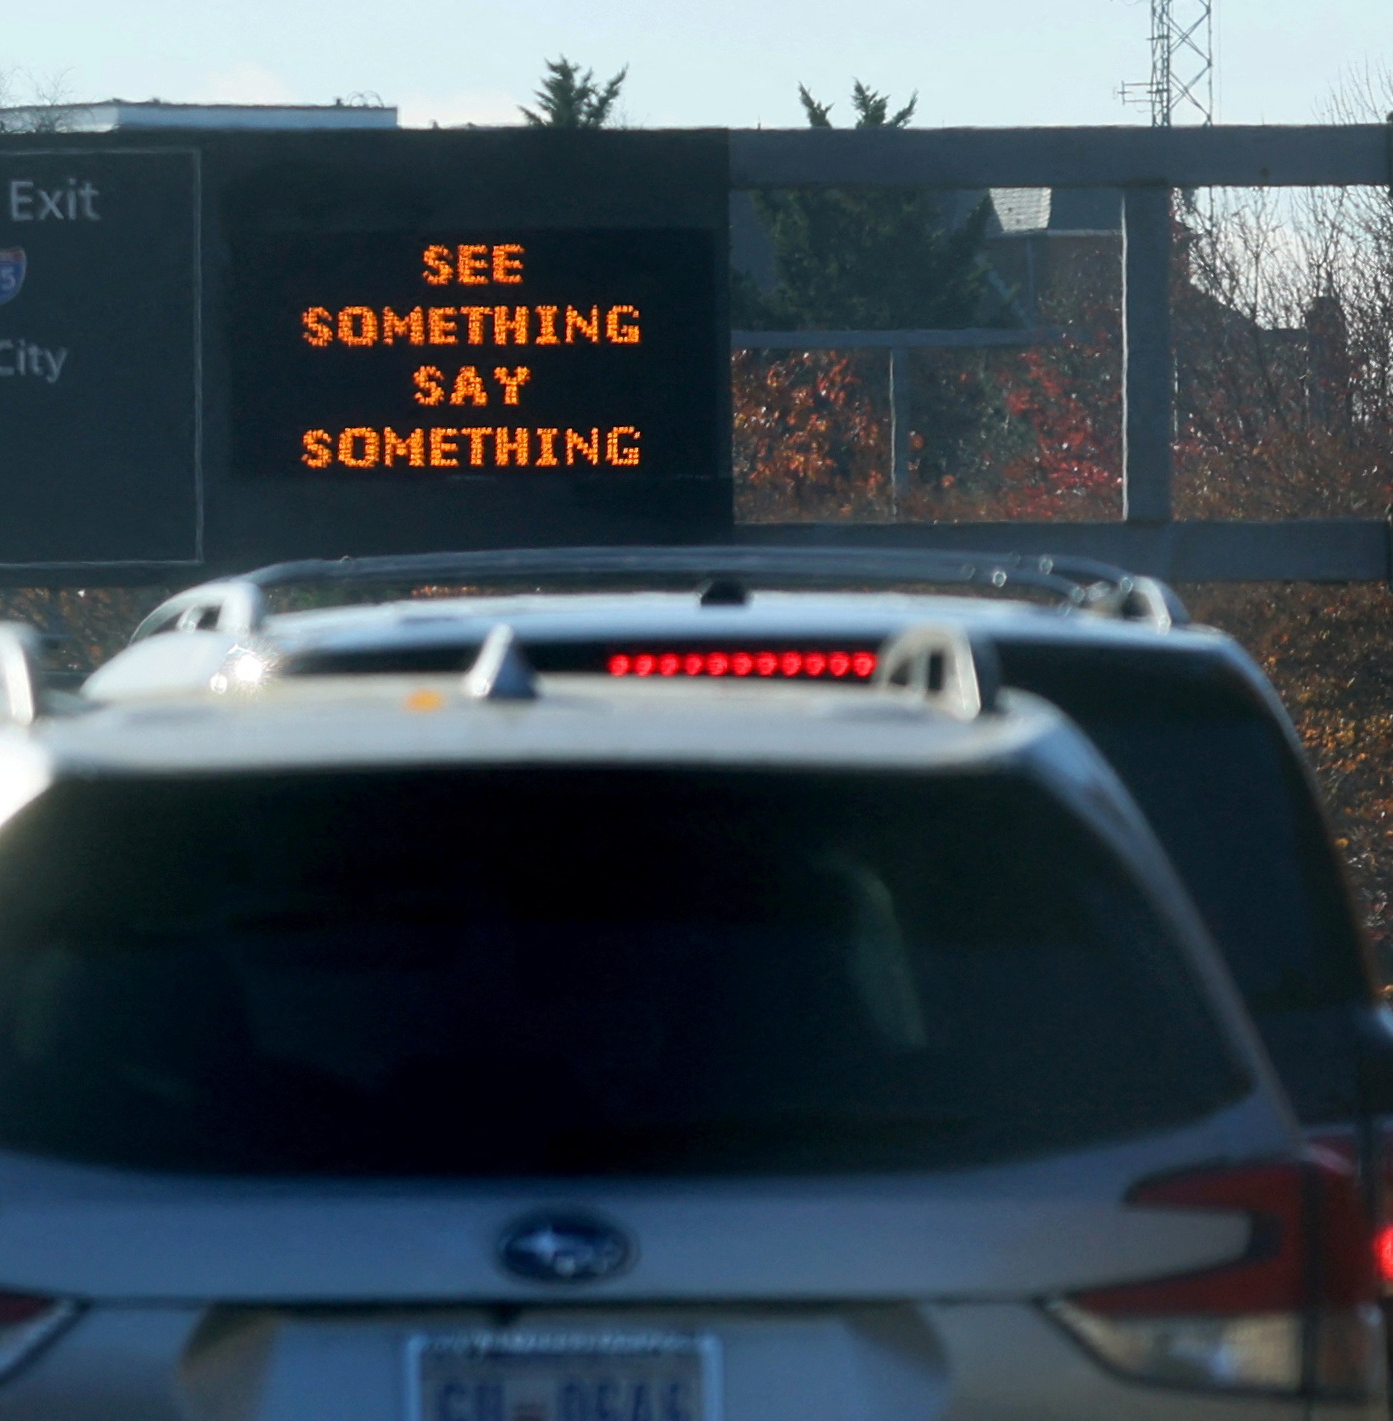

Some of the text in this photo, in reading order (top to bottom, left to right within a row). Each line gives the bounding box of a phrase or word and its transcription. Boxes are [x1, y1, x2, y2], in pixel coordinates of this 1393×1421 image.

[9, 177, 99, 221] Exit
[422, 243, 524, 286] SEE
[302, 304, 641, 347] SOMETHING
[412, 365, 531, 407] SAY
[301, 426, 641, 469] SOMETHING
